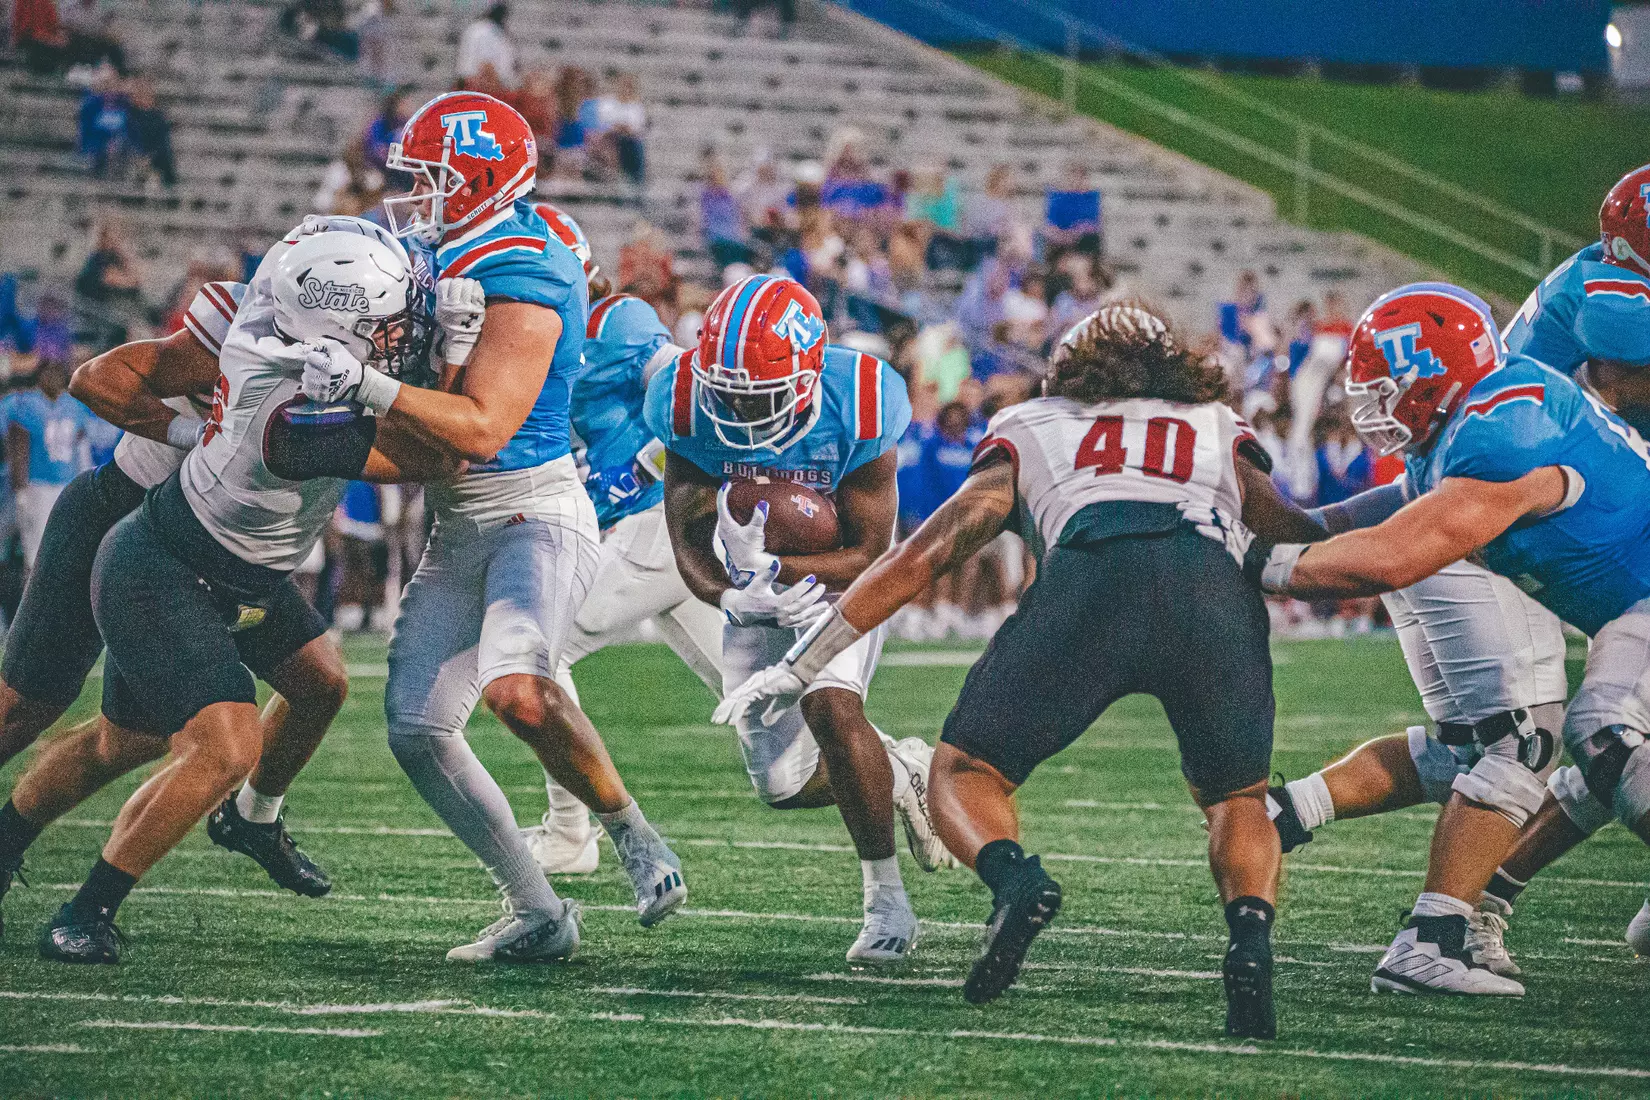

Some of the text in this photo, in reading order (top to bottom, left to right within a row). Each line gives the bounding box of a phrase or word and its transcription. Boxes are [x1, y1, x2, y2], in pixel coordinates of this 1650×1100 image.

[466, 202, 488, 220] SCHUTT
[298, 277, 370, 314] State
[329, 369, 351, 398] adidas
[1074, 415, 1198, 485] 40
